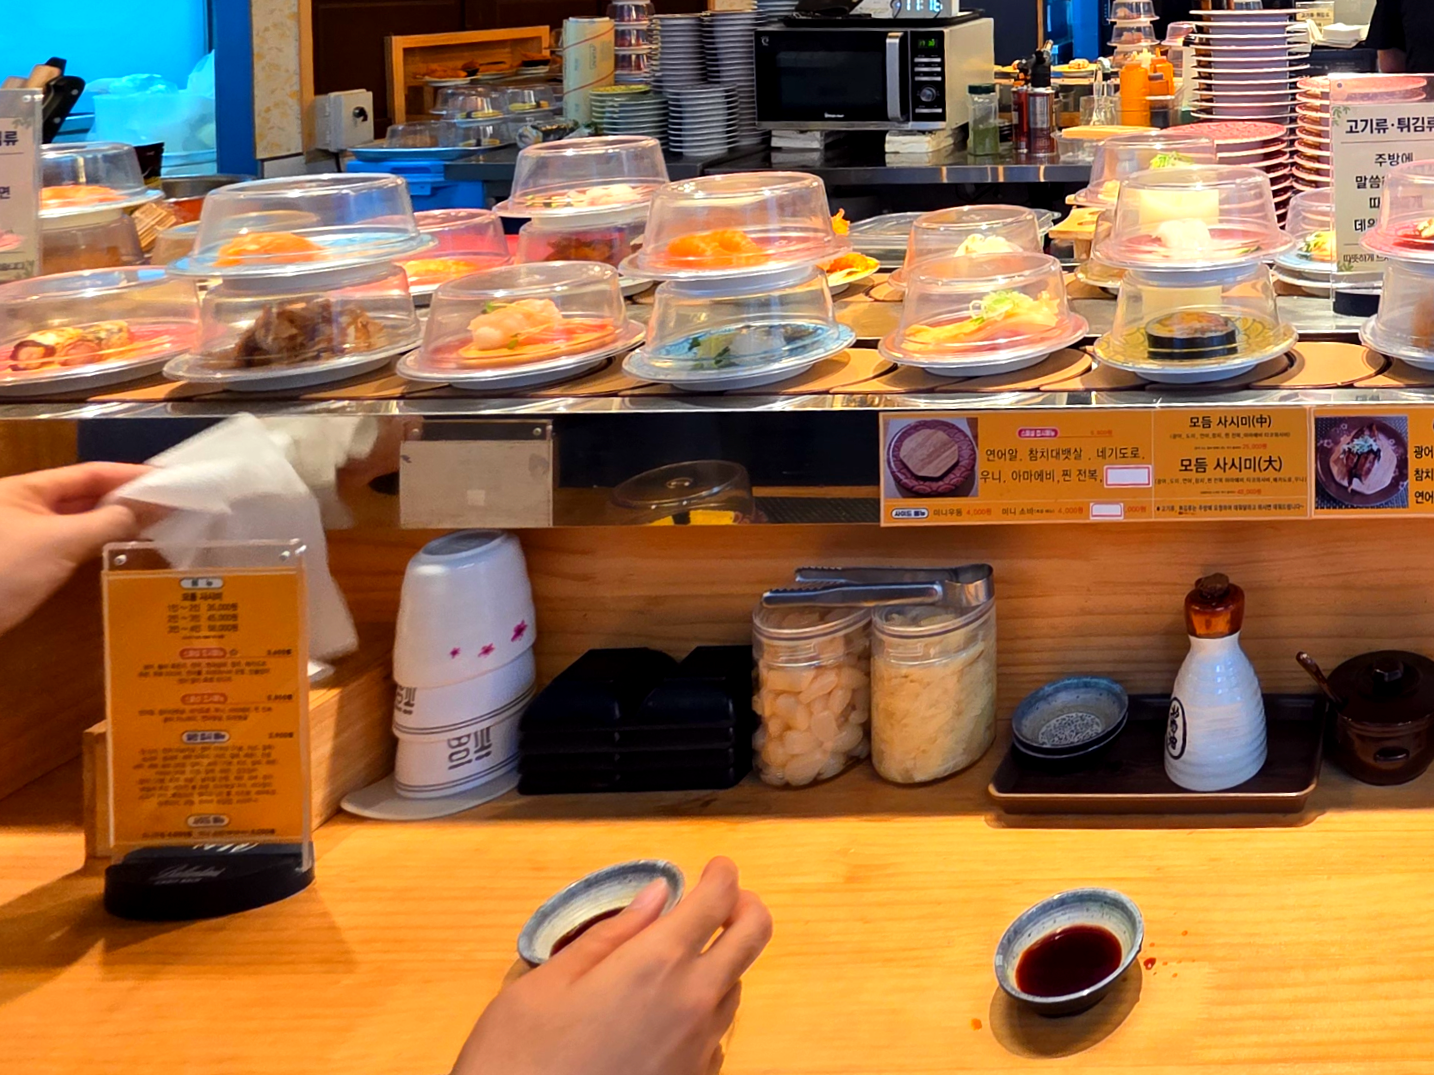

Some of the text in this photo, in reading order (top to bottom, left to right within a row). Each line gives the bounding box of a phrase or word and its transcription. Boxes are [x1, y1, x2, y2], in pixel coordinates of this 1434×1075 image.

[1374, 152, 1414, 167] 주방에
[1189, 414, 1272, 428] 모듬 사시미(中)
[1028, 447, 1083, 461] 참치대뱃살
[1413, 445, 1434, 459] 광어
[1179, 455, 1283, 473] 모듬 사시미(大)
[1414, 468, 1434, 481] 참치
[933, 507, 963, 517] 미니우동
[1001, 507, 1017, 516] 미니
